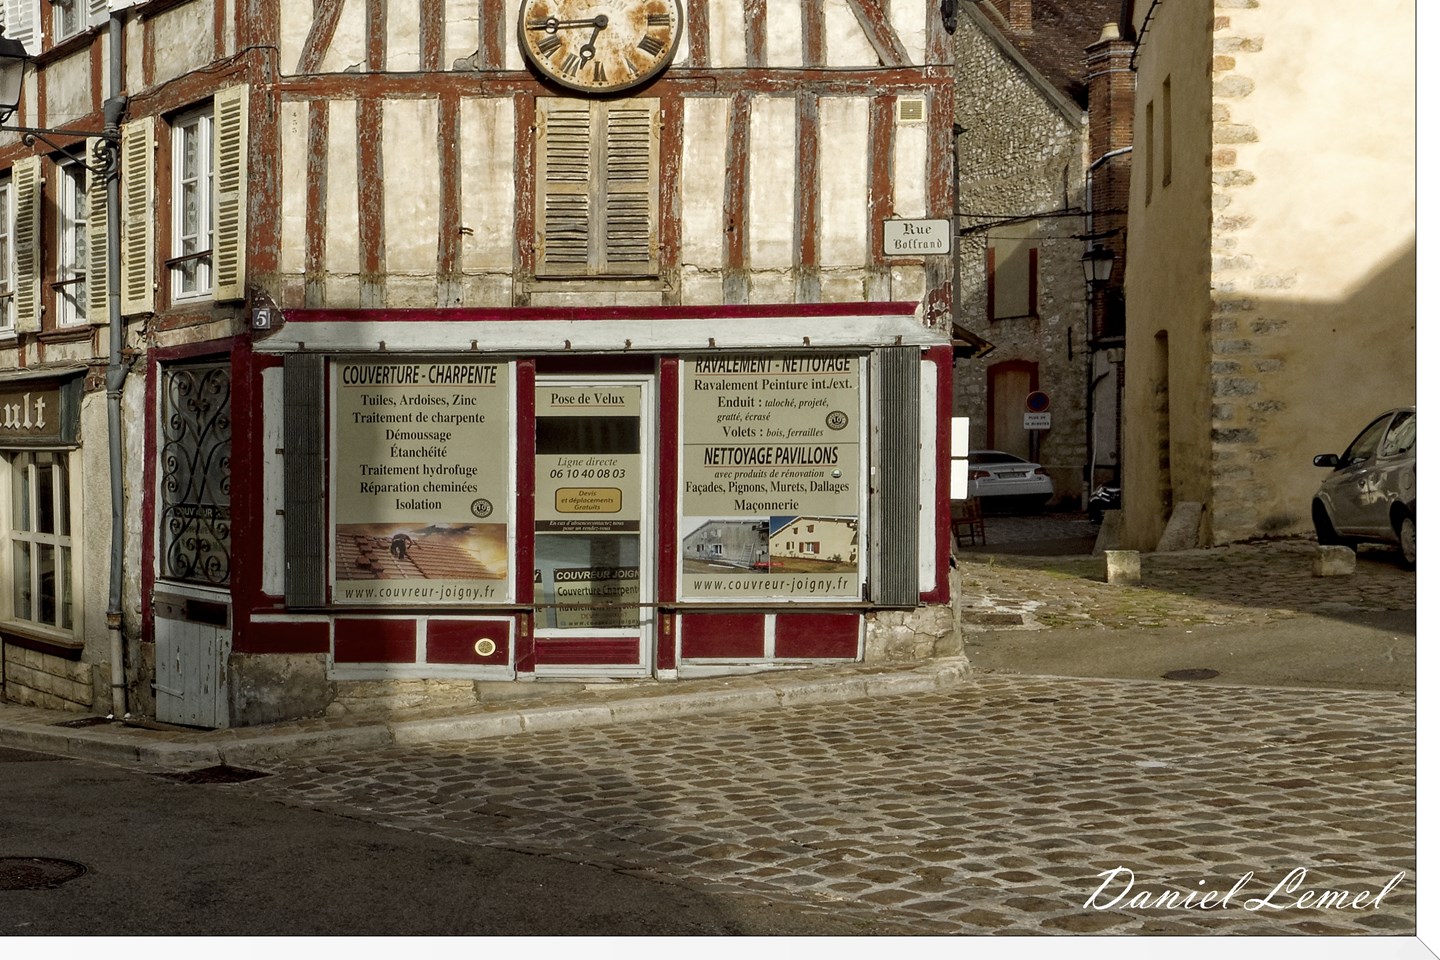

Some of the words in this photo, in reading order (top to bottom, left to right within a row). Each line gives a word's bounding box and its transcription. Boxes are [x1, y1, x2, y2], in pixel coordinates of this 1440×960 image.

[903, 223, 932, 235] Rue
[893, 238, 942, 249] Boffrand
[256, 311, 267, 326] 5
[695, 355, 772, 373] RAVALEMENT
[782, 354, 850, 373] NETTOYAGE
[343, 365, 420, 384] COUVERTURE
[428, 365, 497, 384] CHARPENTE
[694, 379, 758, 391] Ravalement
[761, 378, 808, 390] Peinture
[811, 378, 853, 390] int./ext.
[360, 394, 397, 407] Tuiles,
[400, 394, 450, 407] Ardoises,
[452, 394, 477, 406] Zinc
[551, 393, 575, 404] Pose
[578, 393, 591, 404] de
[594, 392, 625, 404] Velux
[718, 396, 755, 408] Enduit
[764, 397, 797, 408] taloché,
[798, 397, 829, 409] projeté,
[352, 411, 412, 424] Traitement
[415, 411, 429, 423] de
[431, 411, 486, 425] charpente
[717, 412, 743, 423] gratté,
[745, 411, 771, 422] écrasé
[385, 429, 452, 443] Démoussage
[723, 426, 757, 437] Volets
[766, 427, 785, 438] bois,
[786, 427, 824, 439] ferrailles
[390, 443, 448, 457] Étanchéité
[704, 447, 773, 465] NETTOYAGE
[774, 446, 839, 464] PAVILLONS
[557, 458, 584, 468] Ligne
[586, 457, 618, 466] directe
[360, 464, 419, 475] Traitement
[423, 463, 478, 478] hydrofuge
[550, 469, 563, 478] 06
[567, 469, 579, 478] 10
[581, 469, 595, 478] 40
[596, 469, 610, 478] 08
[612, 469, 626, 478] 03
[714, 470, 733, 479] avec
[734, 469, 768, 480] produits
[769, 469, 780, 478] de
[781, 469, 824, 478] rénovation
[360, 481, 419, 495] Réparation
[422, 481, 478, 493] cheminées
[686, 481, 726, 495] Façades,
[728, 481, 768, 495] Pignons,
[770, 481, 807, 494] Murets,
[810, 480, 850, 495] Dallages
[396, 498, 442, 510] Isolation
[734, 499, 799, 513] Maçonnerie
[556, 571, 610, 580] COUVREUR
[557, 586, 601, 596] Couverture
[603, 585, 639, 596] Charpent
[694, 577, 849, 592] www.couvreur-joigny.fr
[345, 585, 495, 600] www.couvreur-joigny.fr
